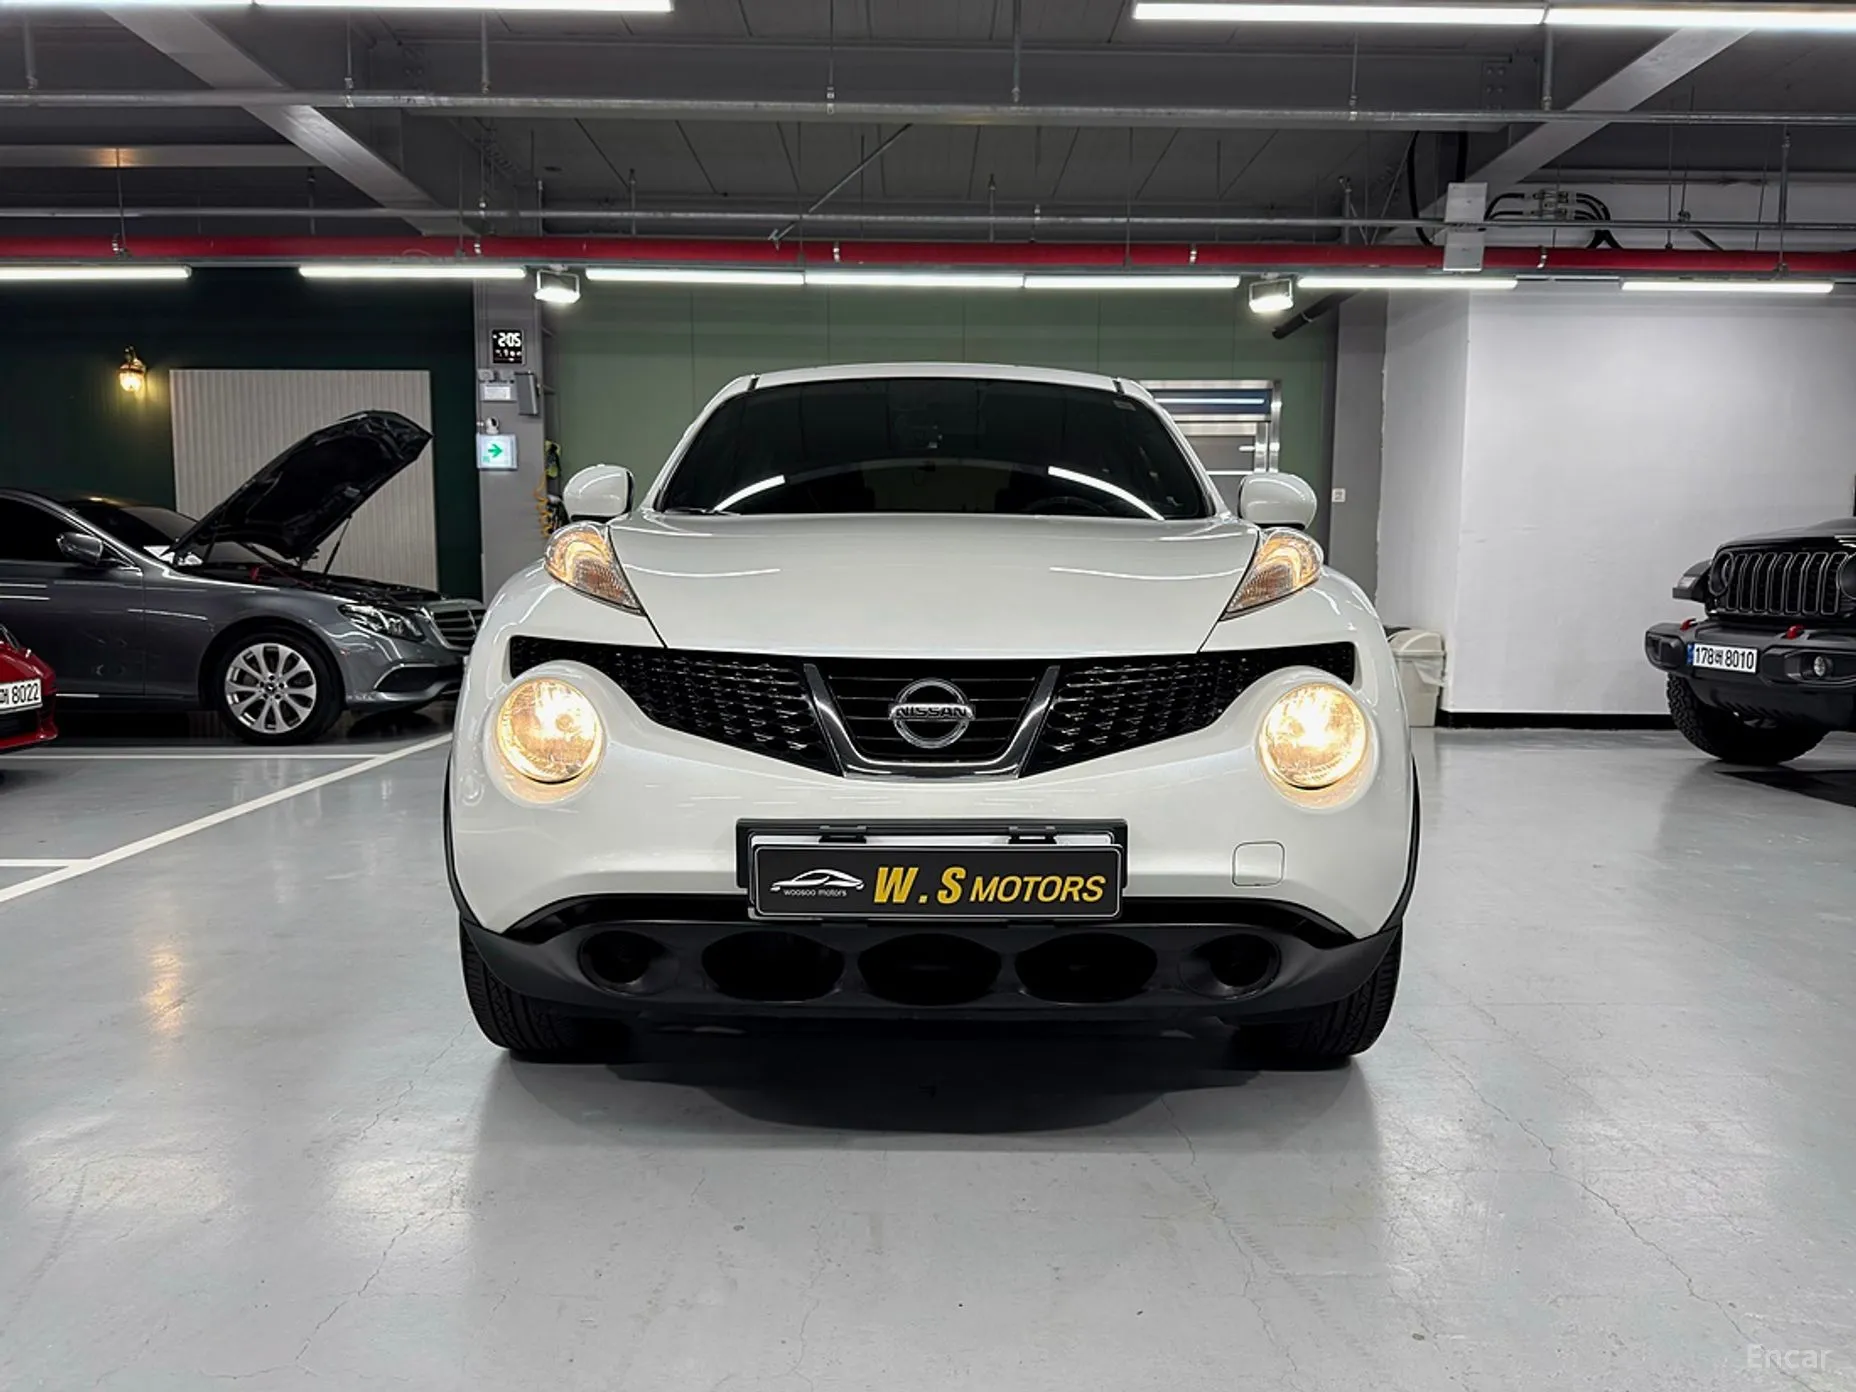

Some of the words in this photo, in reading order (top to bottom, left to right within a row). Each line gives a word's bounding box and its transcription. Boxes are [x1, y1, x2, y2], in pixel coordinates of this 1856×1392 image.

[896, 706, 966, 718] NISSAN
[818, 889, 847, 897] motors
[970, 875, 1106, 902] MOTORS
